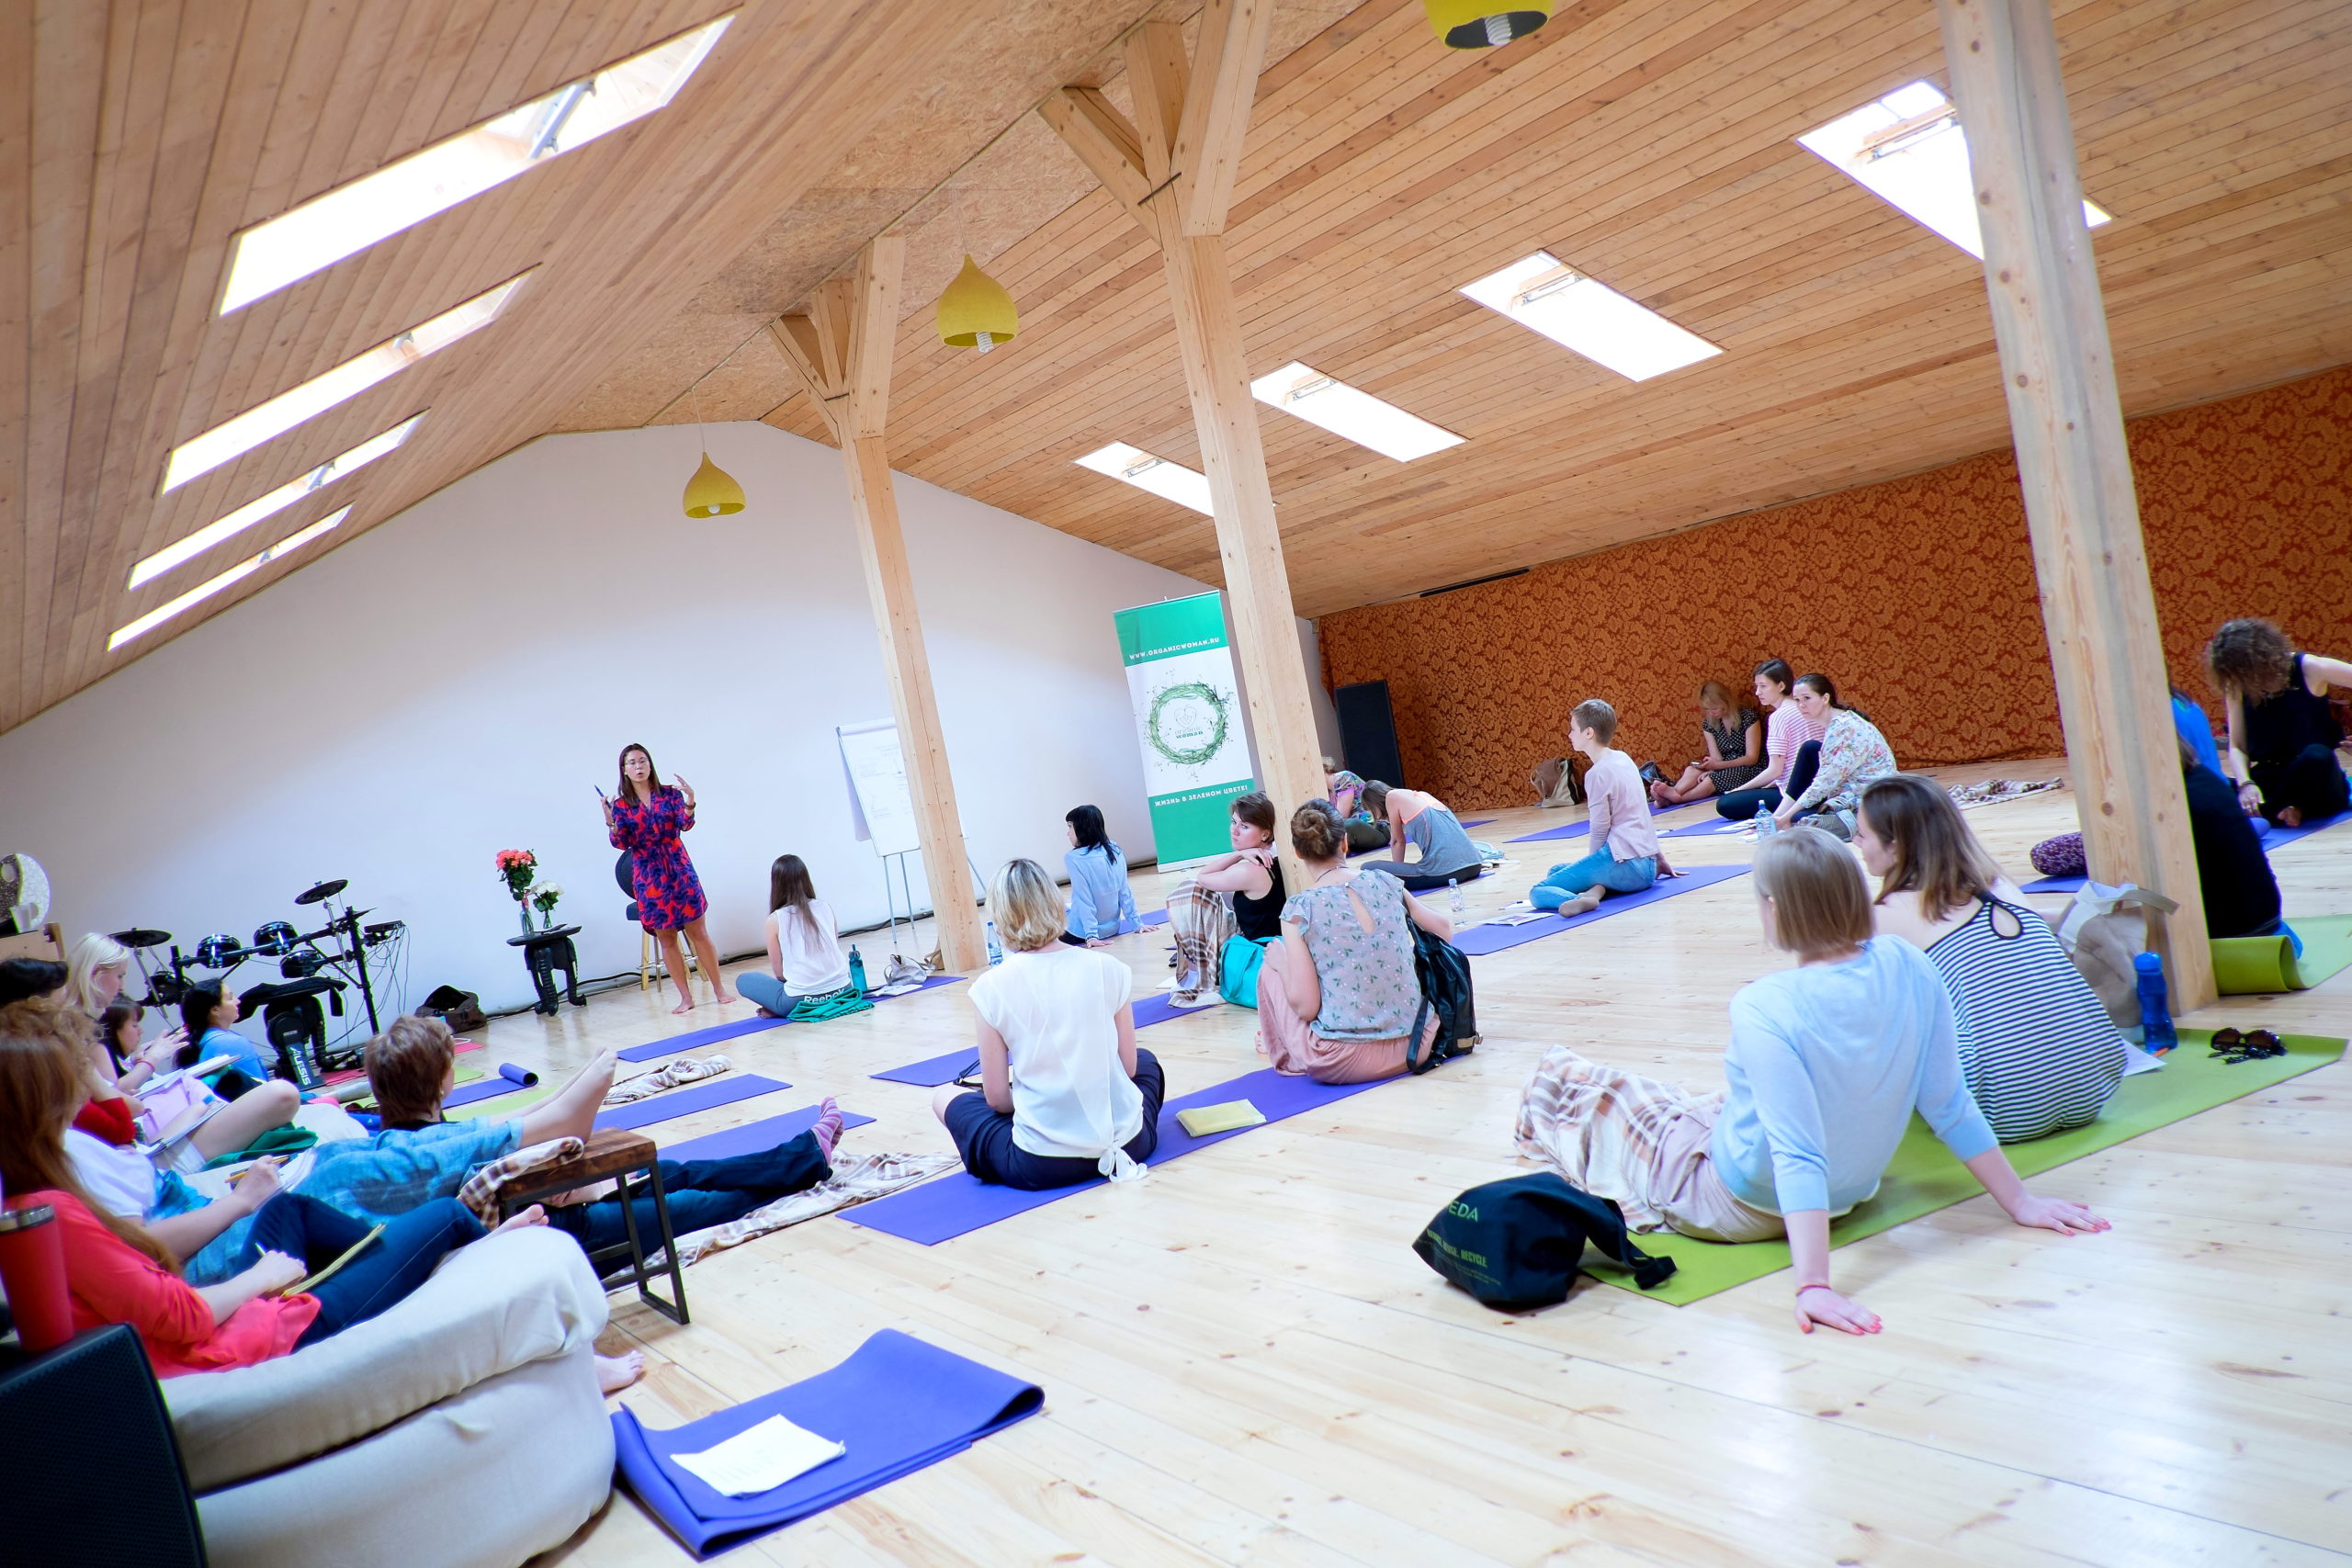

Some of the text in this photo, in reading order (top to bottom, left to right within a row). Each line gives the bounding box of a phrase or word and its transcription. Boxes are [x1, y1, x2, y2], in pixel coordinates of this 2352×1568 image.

[1129, 637, 1220, 660] WWW.ORGANICWOMAN.RU
[1154, 797, 1180, 807] ЖИЗНЬ
[1189, 789, 1222, 801] ЗЕЛЕНОМ
[1223, 784, 1248, 795] ЦВЕТЕ!
[289, 1046, 311, 1086] ALESIS
